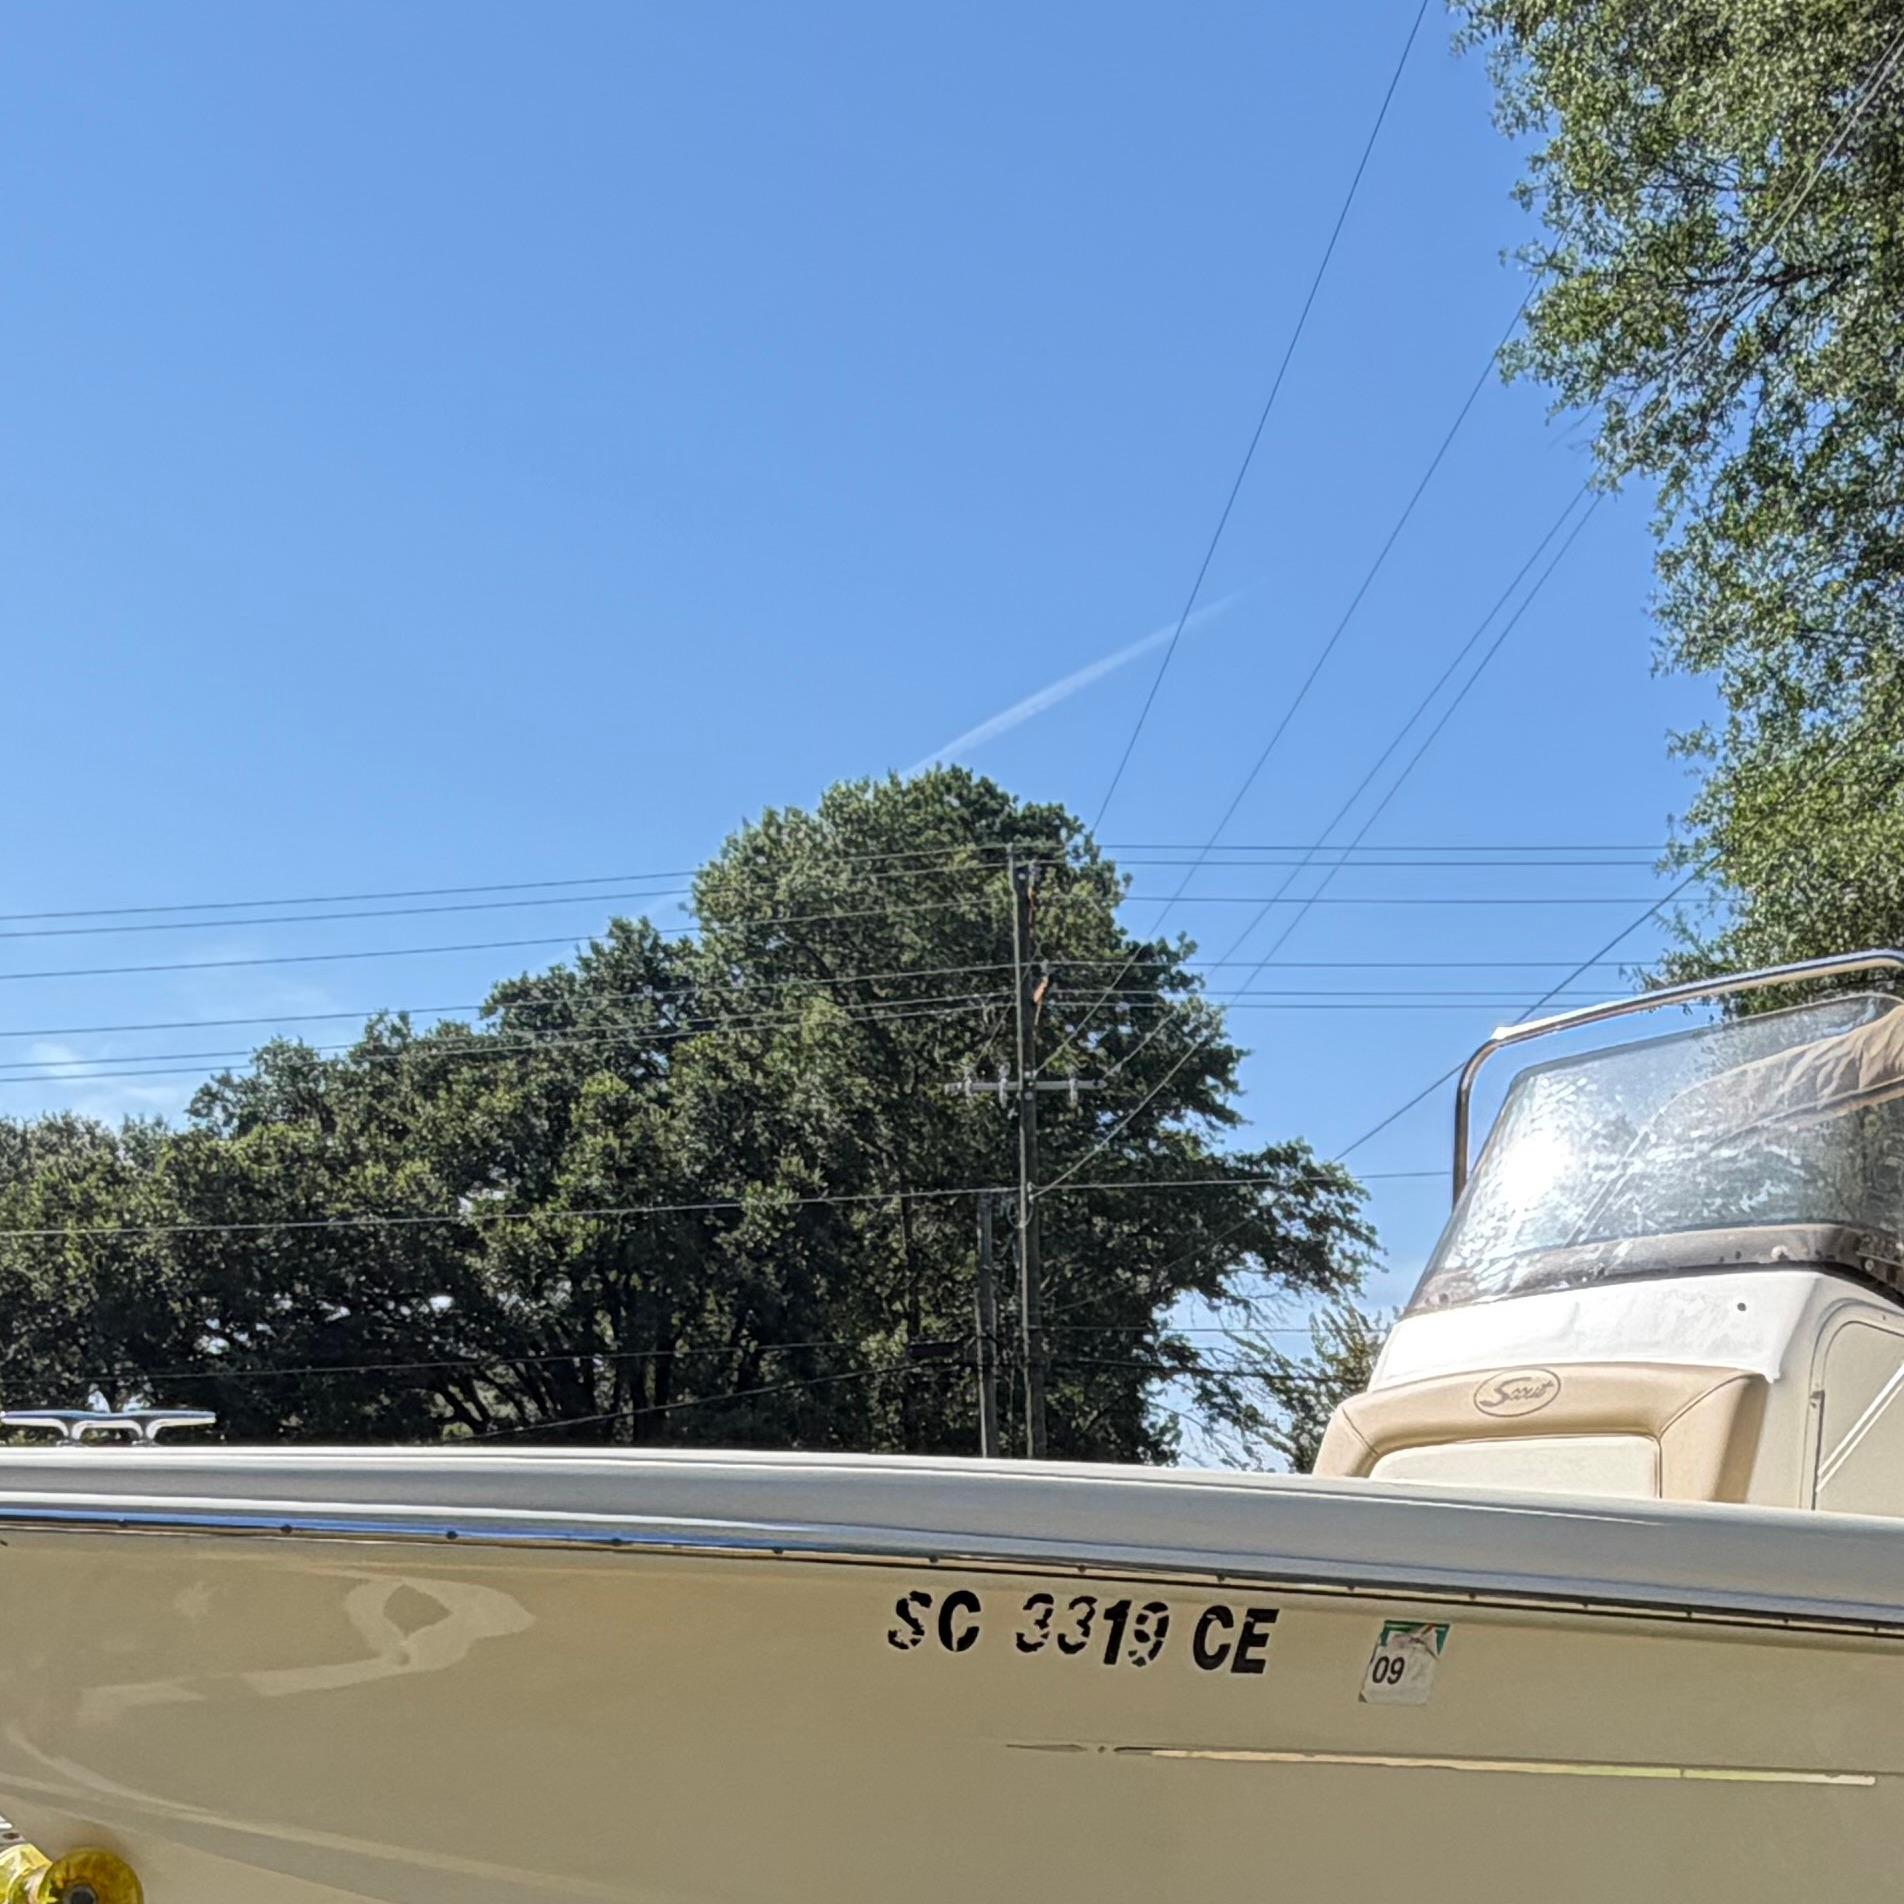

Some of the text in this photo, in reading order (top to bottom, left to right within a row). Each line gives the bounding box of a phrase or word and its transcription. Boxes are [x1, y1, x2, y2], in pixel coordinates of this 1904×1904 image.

[1478, 1376, 1554, 1408] Scout
[887, 1590, 1280, 1674] SC 3319 CE
[1372, 1655, 1405, 1685] 09
